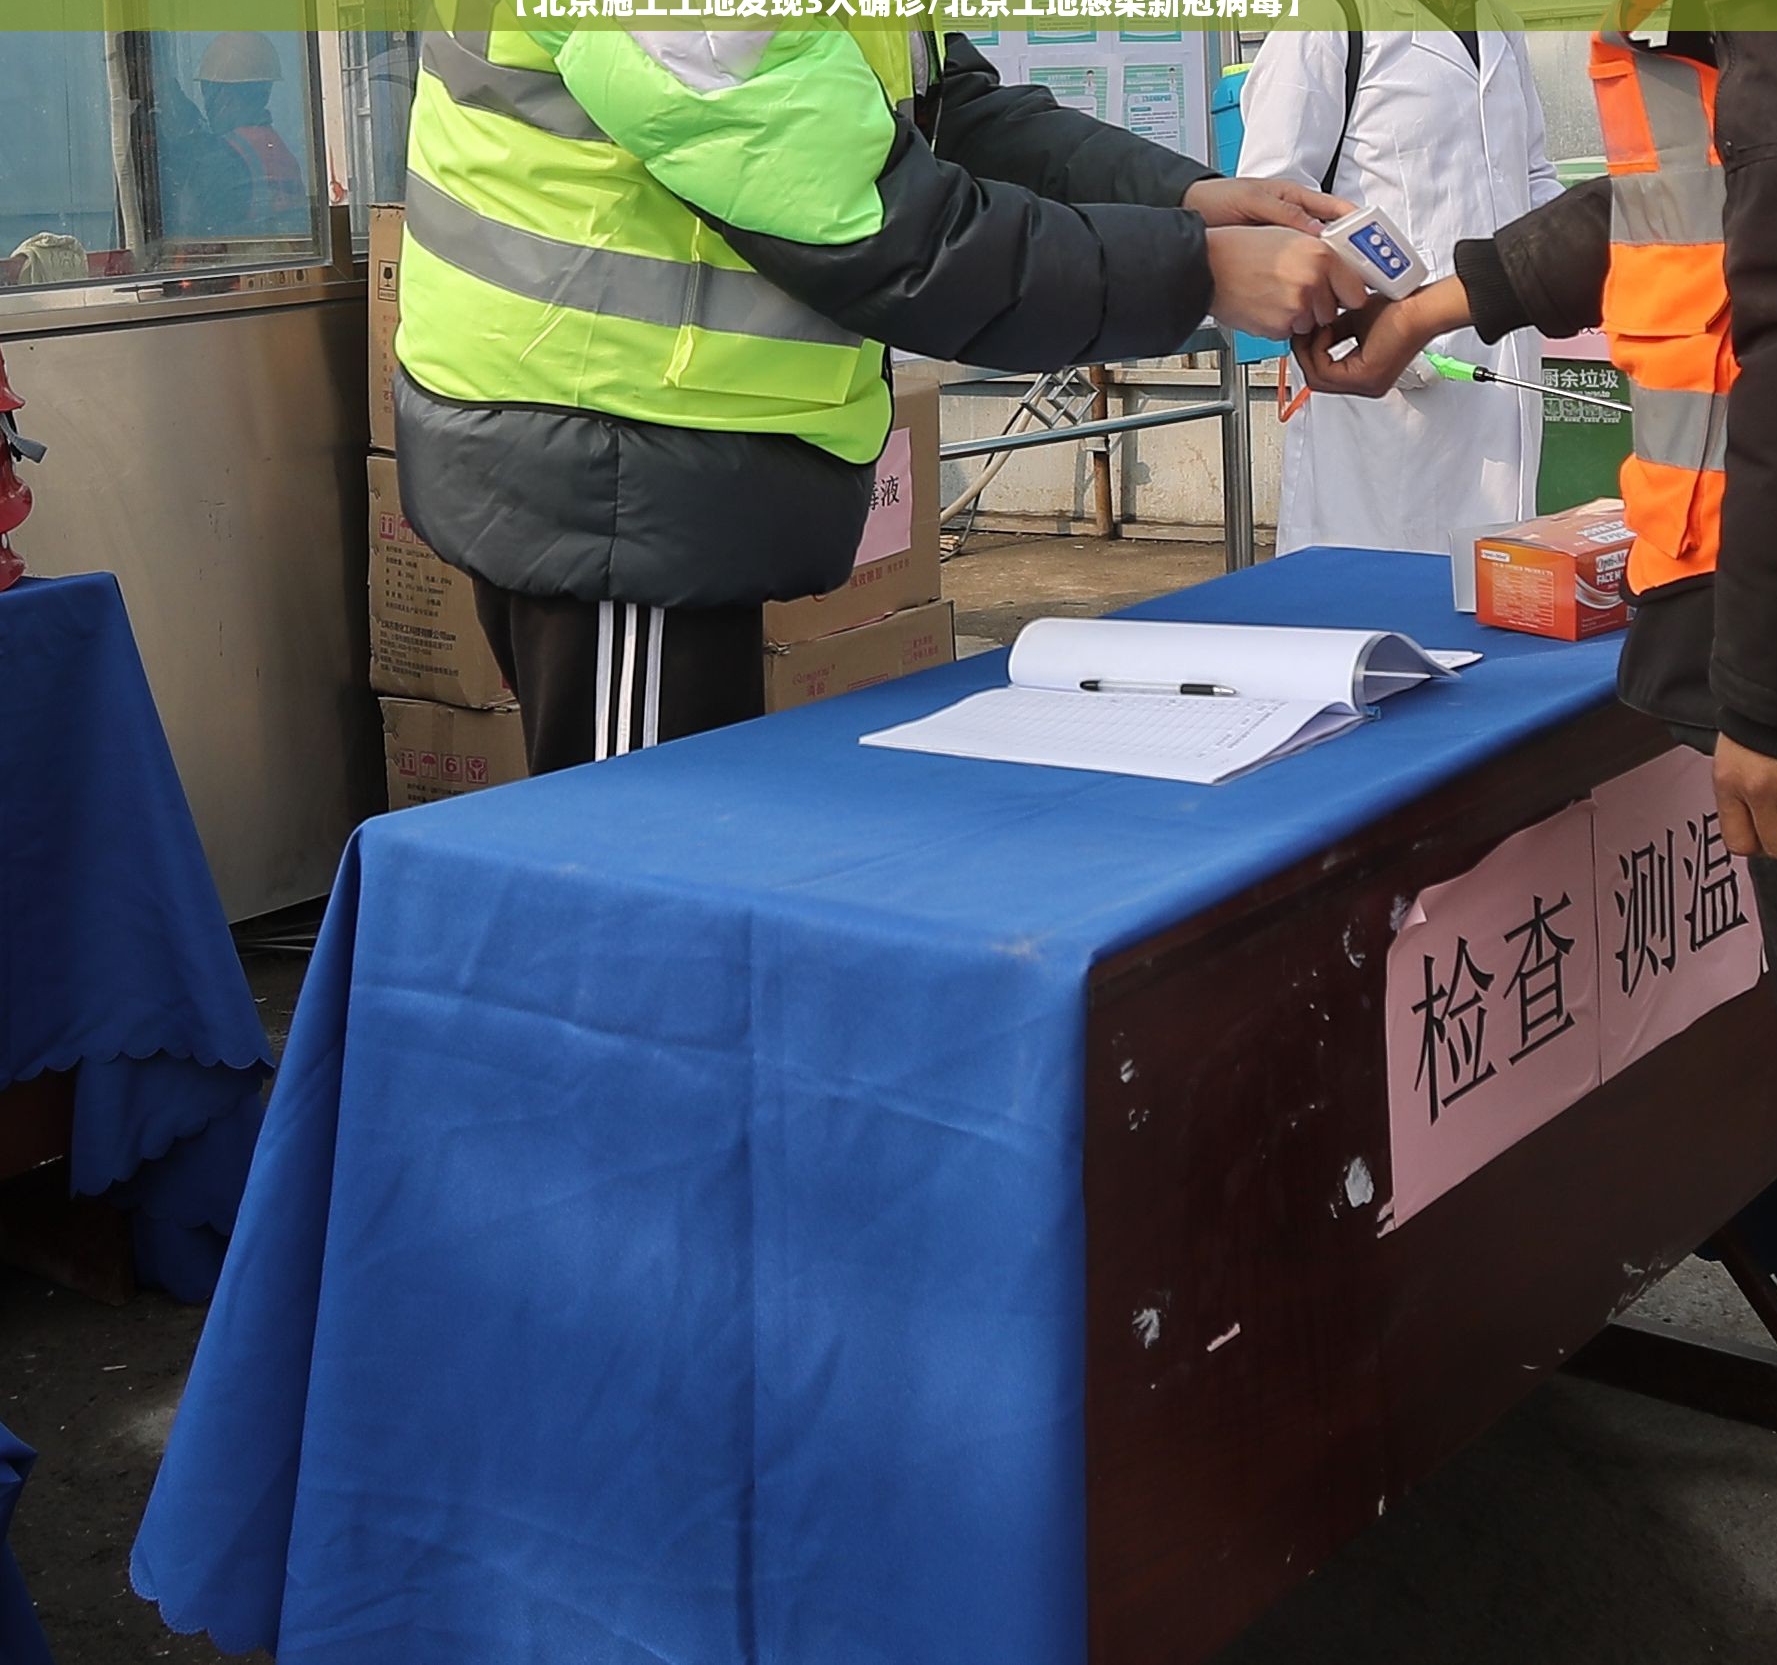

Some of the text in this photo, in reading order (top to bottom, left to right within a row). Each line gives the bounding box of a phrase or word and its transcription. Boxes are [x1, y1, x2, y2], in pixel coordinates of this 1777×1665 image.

[1543, 368, 1619, 388] 厨余垃圾
[1410, 811, 1750, 1126] 检查 测温
